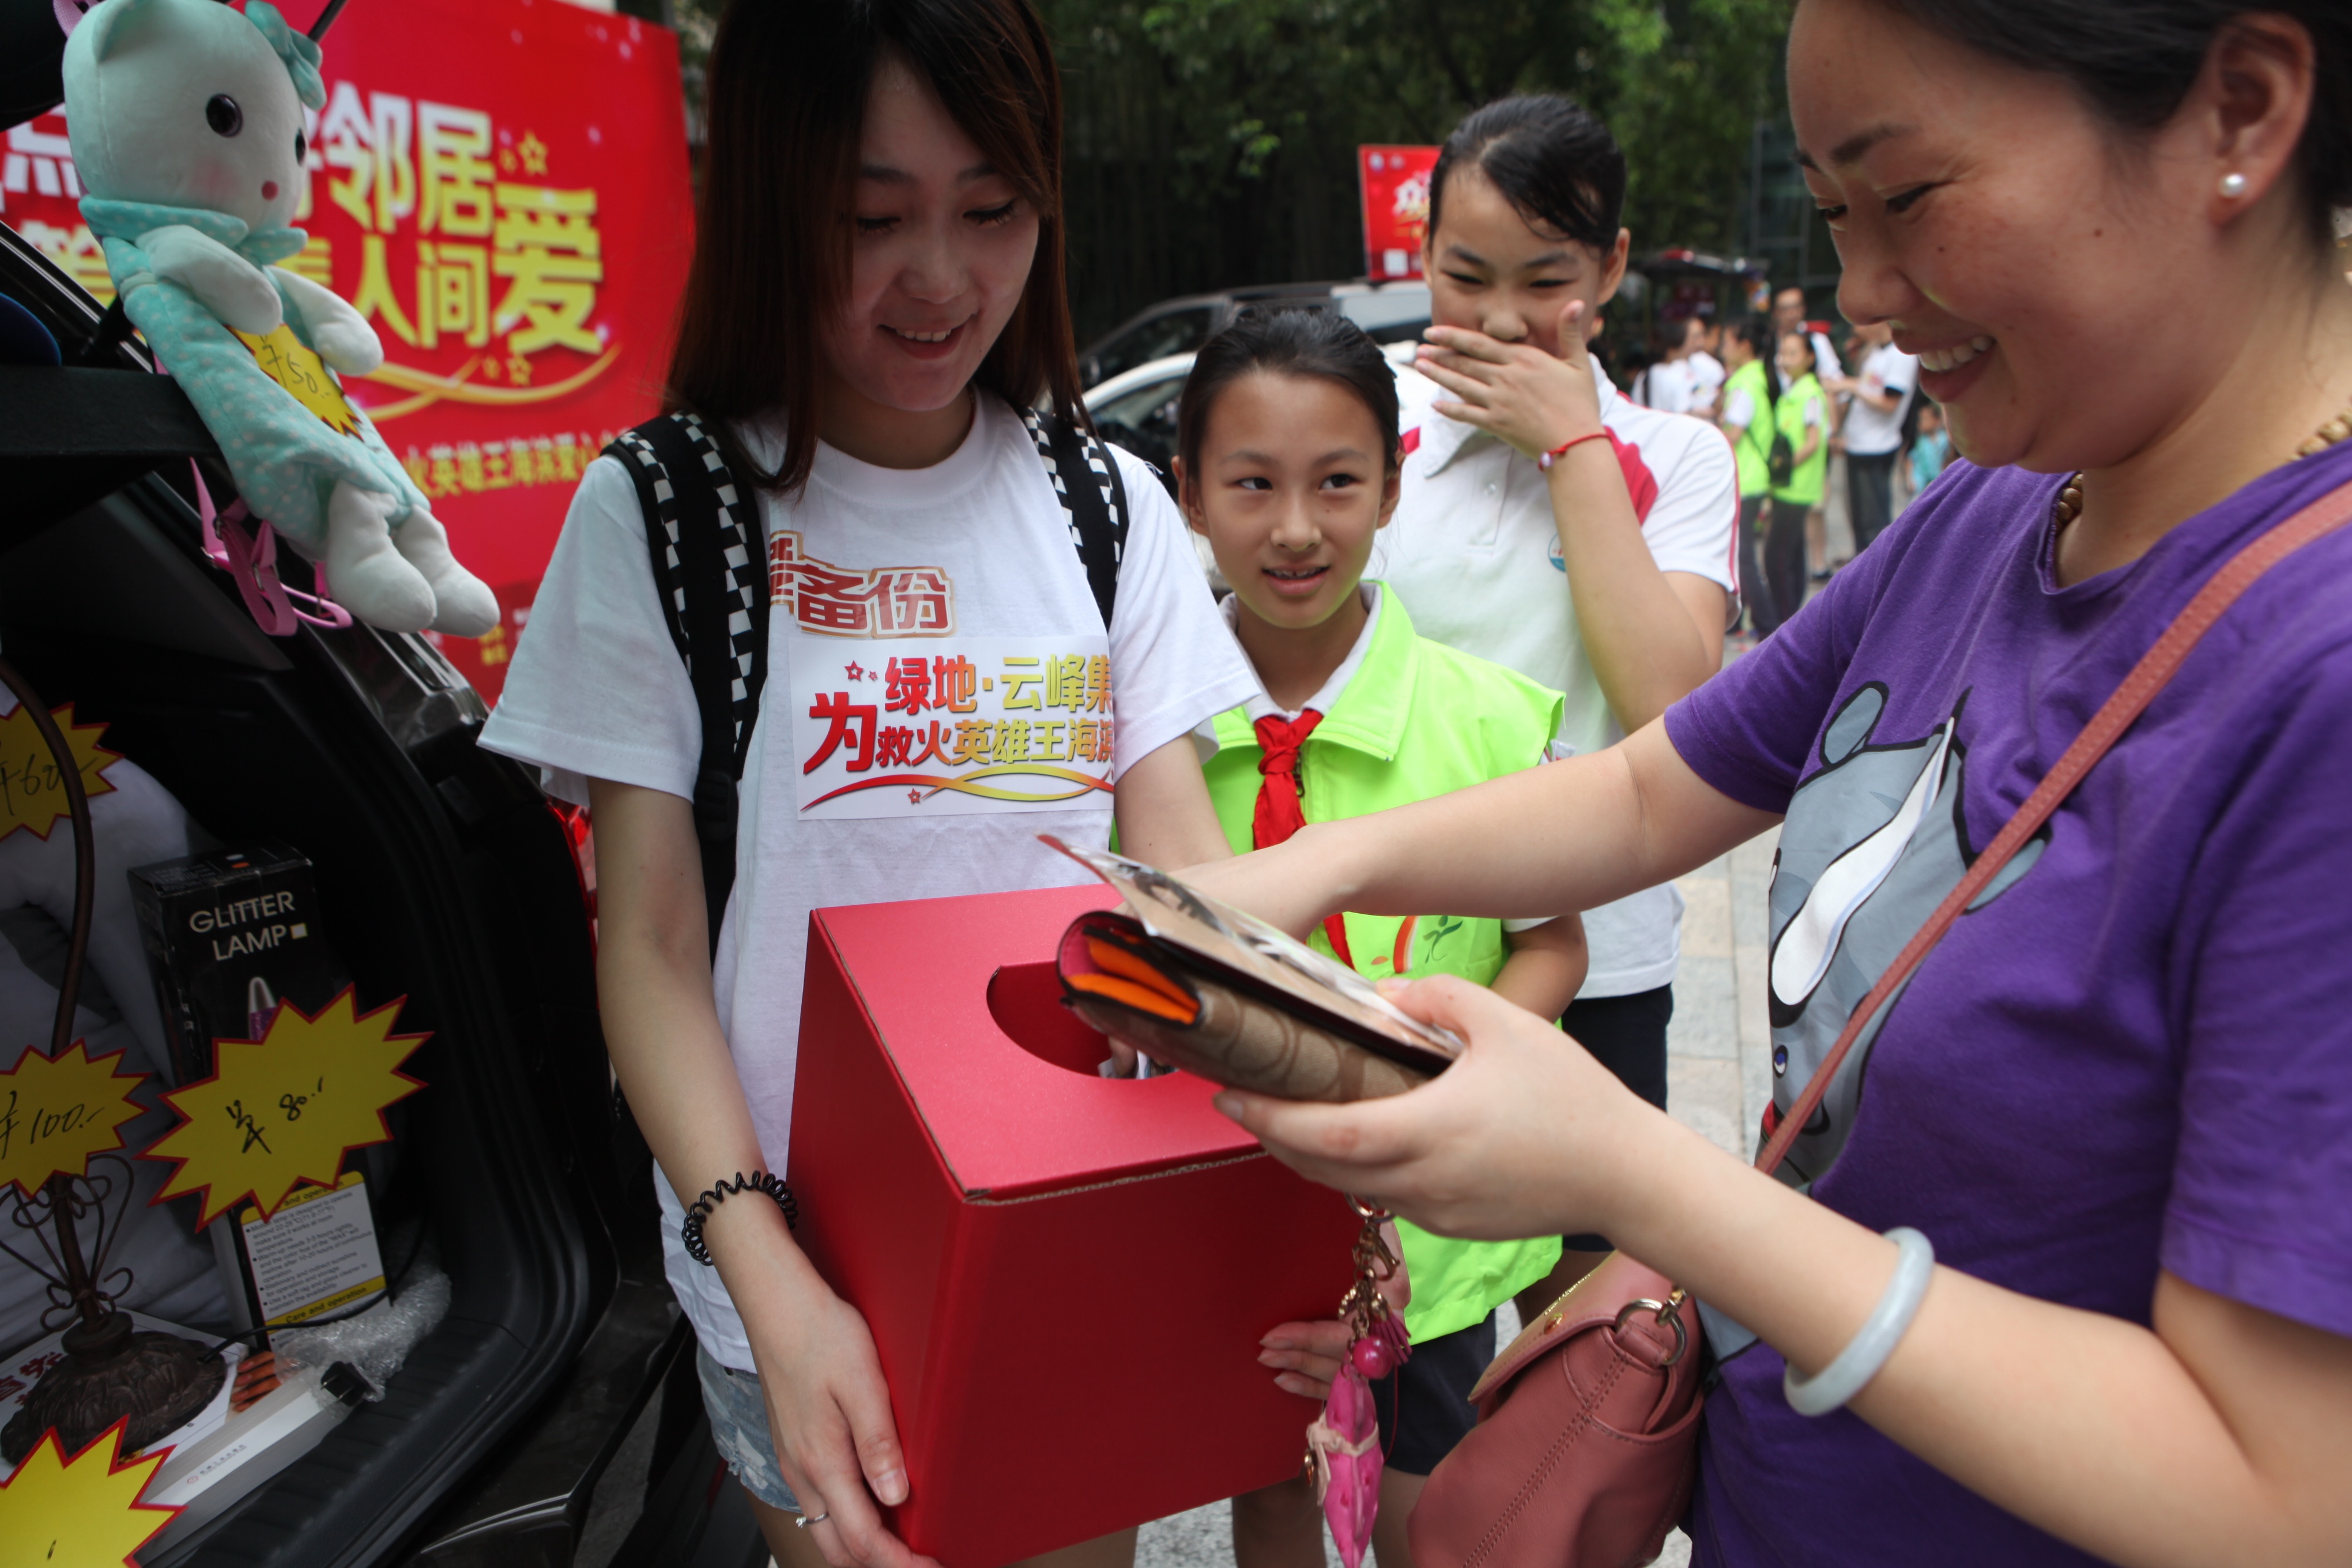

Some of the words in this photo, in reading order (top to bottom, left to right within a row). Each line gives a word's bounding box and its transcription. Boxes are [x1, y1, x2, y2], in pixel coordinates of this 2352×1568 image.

[304, 82, 495, 236] 邻居
[770, 536, 949, 631] 备份
[189, 890, 295, 933] GLITTER
[212, 924, 288, 962] LAMP
[285, 1310, 306, 1325] Care
[308, 1303, 324, 1314] and
[327, 1286, 367, 1309] operation
